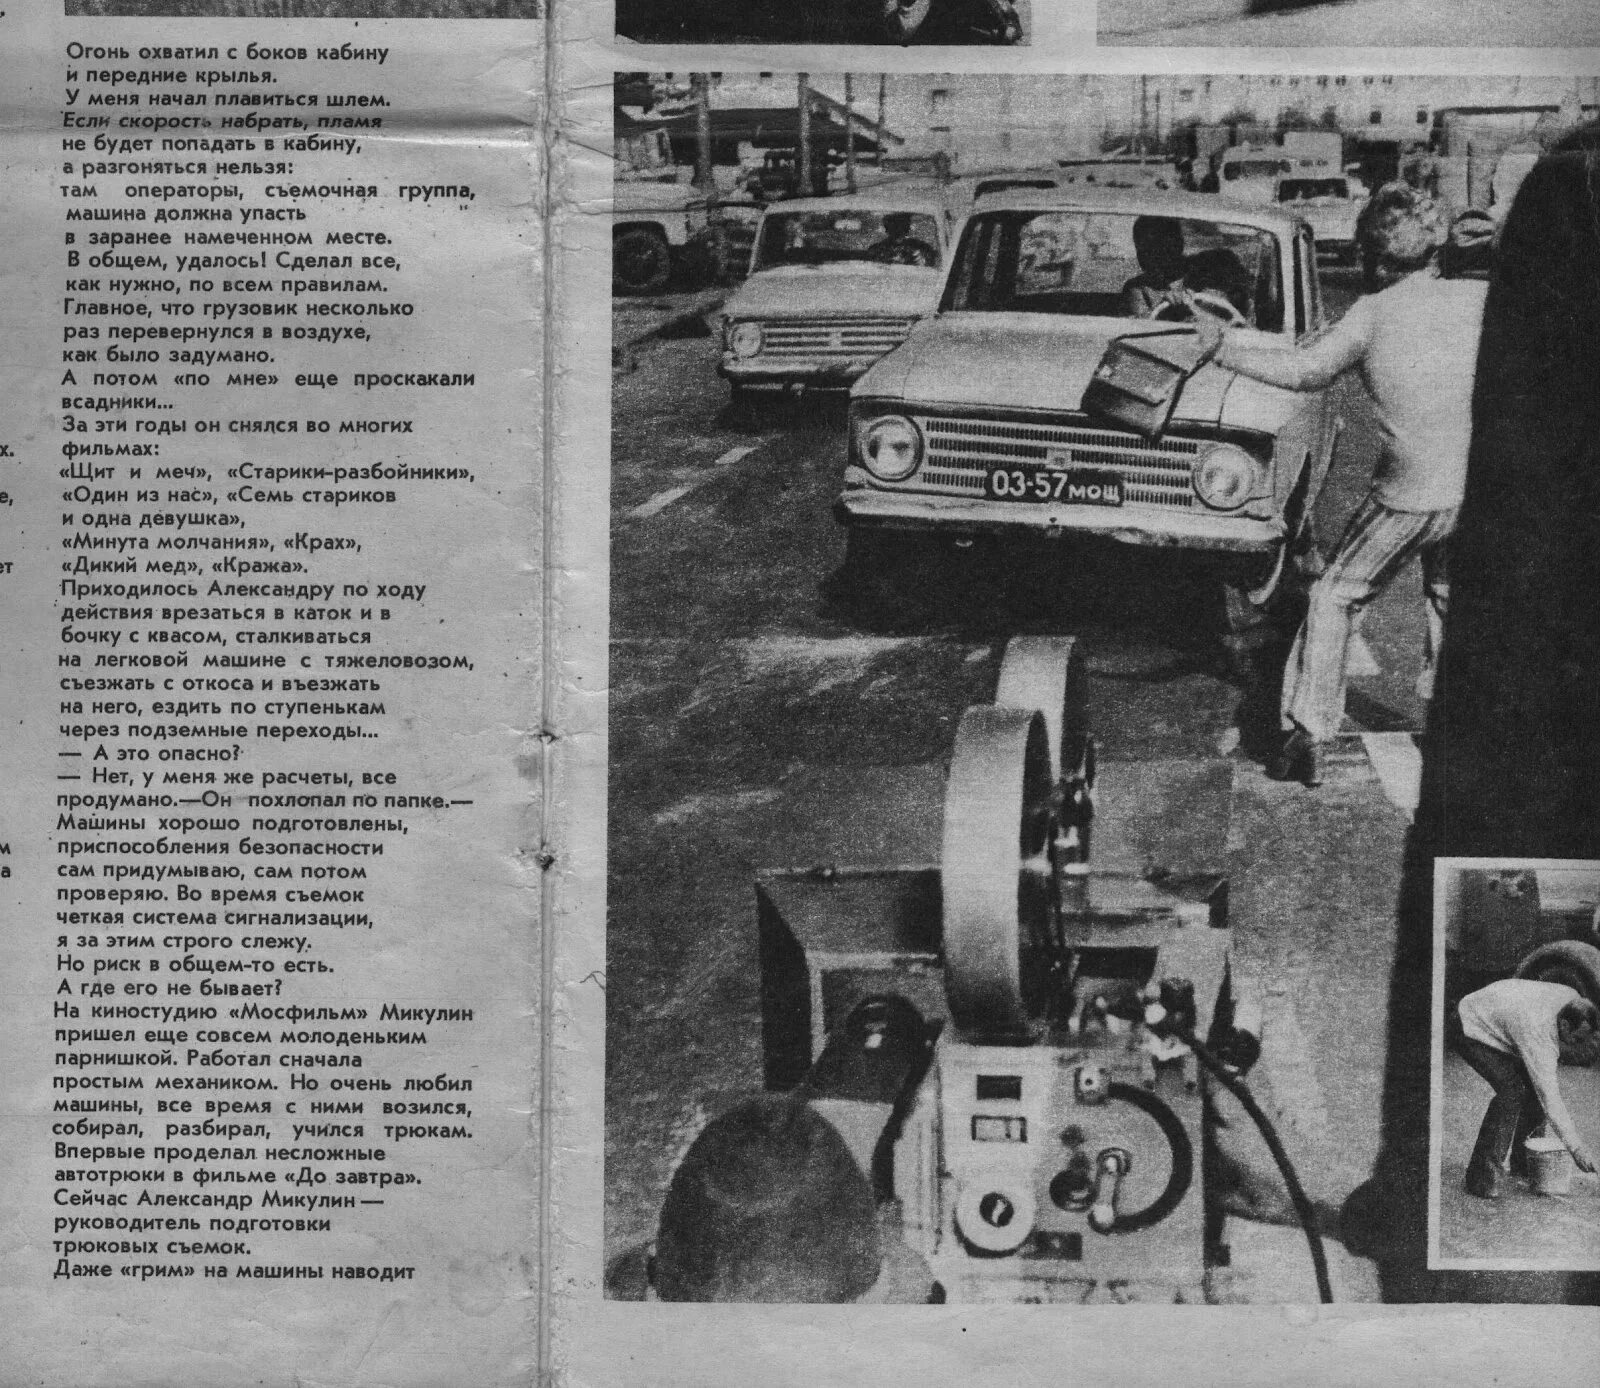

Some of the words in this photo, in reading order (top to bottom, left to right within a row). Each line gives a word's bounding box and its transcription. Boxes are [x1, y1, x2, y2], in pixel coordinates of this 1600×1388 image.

[65, 41, 130, 60] Огонь
[138, 46, 219, 60] охватил
[226, 47, 238, 60] с
[246, 41, 308, 61] боков
[316, 41, 390, 66] кабину
[66, 69, 78, 83] и
[86, 69, 188, 87] передние
[195, 70, 278, 88] крылья.
[65, 87, 81, 106] У
[87, 93, 140, 107] меня
[148, 93, 207, 107] начал
[214, 93, 319, 107] плавиться
[326, 94, 391, 108] шлем.
[62, 161, 74, 175] а
[82, 161, 207, 180] разгоняться
[213, 161, 294, 181] нельзя:
[59, 185, 98, 198] там
[124, 185, 244, 203] операторы,
[264, 184, 378, 204] съемочная
[398, 184, 476, 203] группа,
[65, 208, 147, 222] машина
[153, 208, 233, 224] должна
[239, 207, 307, 225] упасть
[64, 231, 76, 246] в
[88, 231, 172, 249] заранее
[184, 231, 313, 245] намеченном
[325, 231, 393, 246] месте.
[65, 278, 101, 292] как
[109, 279, 181, 296] нужно,
[189, 279, 214, 292] по
[222, 279, 274, 293] всем
[281, 279, 388, 297] правилам.
[63, 297, 153, 319] Главное,
[161, 302, 195, 316] что
[203, 302, 298, 321] грузовик
[306, 303, 415, 317] несколько
[63, 326, 100, 344] раз
[108, 326, 254, 344] перевернулся
[262, 326, 273, 339] в
[281, 326, 371, 344] воздухе,
[62, 349, 98, 363] как
[106, 343, 160, 363] было
[168, 350, 275, 367] задумано.
[60, 368, 78, 386] А
[93, 373, 158, 386] потом
[173, 373, 211, 387] «по
[226, 373, 279, 386] мне»
[294, 373, 339, 390] еще
[353, 373, 476, 391] проскакали
[61, 440, 160, 461] фильмах:
[58, 461, 116, 483] «Щит
[129, 467, 142, 480] и
[155, 465, 212, 483] меч»,
[992, 469, 1068, 498] 03-57
[62, 484, 129, 506] «Один
[136, 489, 160, 503] из
[167, 486, 218, 506] нас»,
[226, 484, 294, 503] «Семь
[301, 490, 397, 508] стариков
[62, 512, 74, 526] и
[81, 513, 132, 529] одна
[138, 512, 246, 531] девушка»,
[61, 531, 149, 554] «Минута
[156, 536, 275, 553] молчания»,
[283, 531, 362, 555] «Крах»,
[61, 555, 137, 576] «Дикий
[145, 559, 204, 577] мед»,
[211, 555, 308, 578] «Кража».
[61, 578, 198, 601] Приходилось
[206, 579, 335, 602] Александру
[343, 584, 369, 597] по
[376, 584, 427, 602] ходу
[61, 624, 122, 648] бочку
[129, 630, 140, 644] с
[147, 630, 227, 648] квасом,
[235, 631, 371, 645] сталкиваться
[58, 654, 82, 668] на
[94, 650, 188, 668] легковой
[202, 654, 287, 668] машине
[300, 655, 312, 669] с
[324, 655, 475, 672] тяжеловозом,
[60, 701, 84, 714] на
[92, 701, 143, 718] него,
[151, 701, 222, 718] ездить
[230, 701, 257, 715] по
[264, 701, 386, 720] ступенькам
[59, 724, 120, 742] через
[128, 724, 249, 741] подземные
[55, 812, 146, 837] Машины
[158, 817, 241, 835] хорошо
[252, 818, 409, 836] подготовлены,
[57, 836, 230, 859] приспособления
[238, 836, 384, 856] безопасности
[56, 864, 96, 878] сам
[103, 864, 245, 883] придумываю,
[253, 865, 293, 879] сам
[300, 865, 367, 881] потом
[57, 888, 169, 906] проверяю.
[176, 883, 203, 902] Во
[210, 888, 277, 906] время
[284, 888, 365, 903] съемок
[56, 911, 124, 925] четкая
[132, 911, 218, 925] система
[224, 910, 374, 930] сигнализации,
[57, 953, 85, 973] Но
[93, 958, 141, 976] риск
[149, 959, 160, 972] в
[283, 959, 335, 974] есть.
[53, 1000, 80, 1019] На
[91, 1005, 218, 1024] киностудию
[229, 1002, 368, 1025] «Мосфильм»
[379, 1002, 475, 1026] Микулин
[54, 1028, 136, 1047] пришел
[144, 1029, 189, 1046] еще
[195, 1029, 272, 1044] совсем
[279, 1030, 428, 1048] молоденьким
[55, 1049, 178, 1070] парнишкой.
[186, 1048, 272, 1067] Работал
[278, 1054, 363, 1068] сначала
[52, 1076, 144, 1094] простым
[154, 1076, 279, 1091] механиком.
[290, 1072, 319, 1092] Но
[329, 1078, 392, 1092] очень
[402, 1072, 473, 1092] любил
[51, 1116, 144, 1140] собирал,
[165, 1117, 271, 1141] разбирал,
[292, 1122, 364, 1142] учился
[383, 1125, 473, 1143] трюкам.
[54, 1141, 146, 1164] Впервые
[153, 1146, 256, 1164] проделал
[265, 1147, 387, 1162] несложные
[54, 1169, 165, 1187] автотрюки
[173, 1170, 184, 1183] в
[192, 1167, 277, 1188] фильме
[284, 1166, 327, 1188] «До
[335, 1171, 422, 1190] завтра».
[54, 1216, 201, 1234] руководитель
[209, 1218, 331, 1235] подготовки
[52, 1240, 159, 1258] трюковых
[166, 1241, 251, 1255] съемок.
[52, 1258, 113, 1280] Даже
[120, 1264, 196, 1282] «грим»
[204, 1265, 229, 1279] на
[235, 1265, 325, 1279] машины
[331, 1265, 416, 1283] наводит
